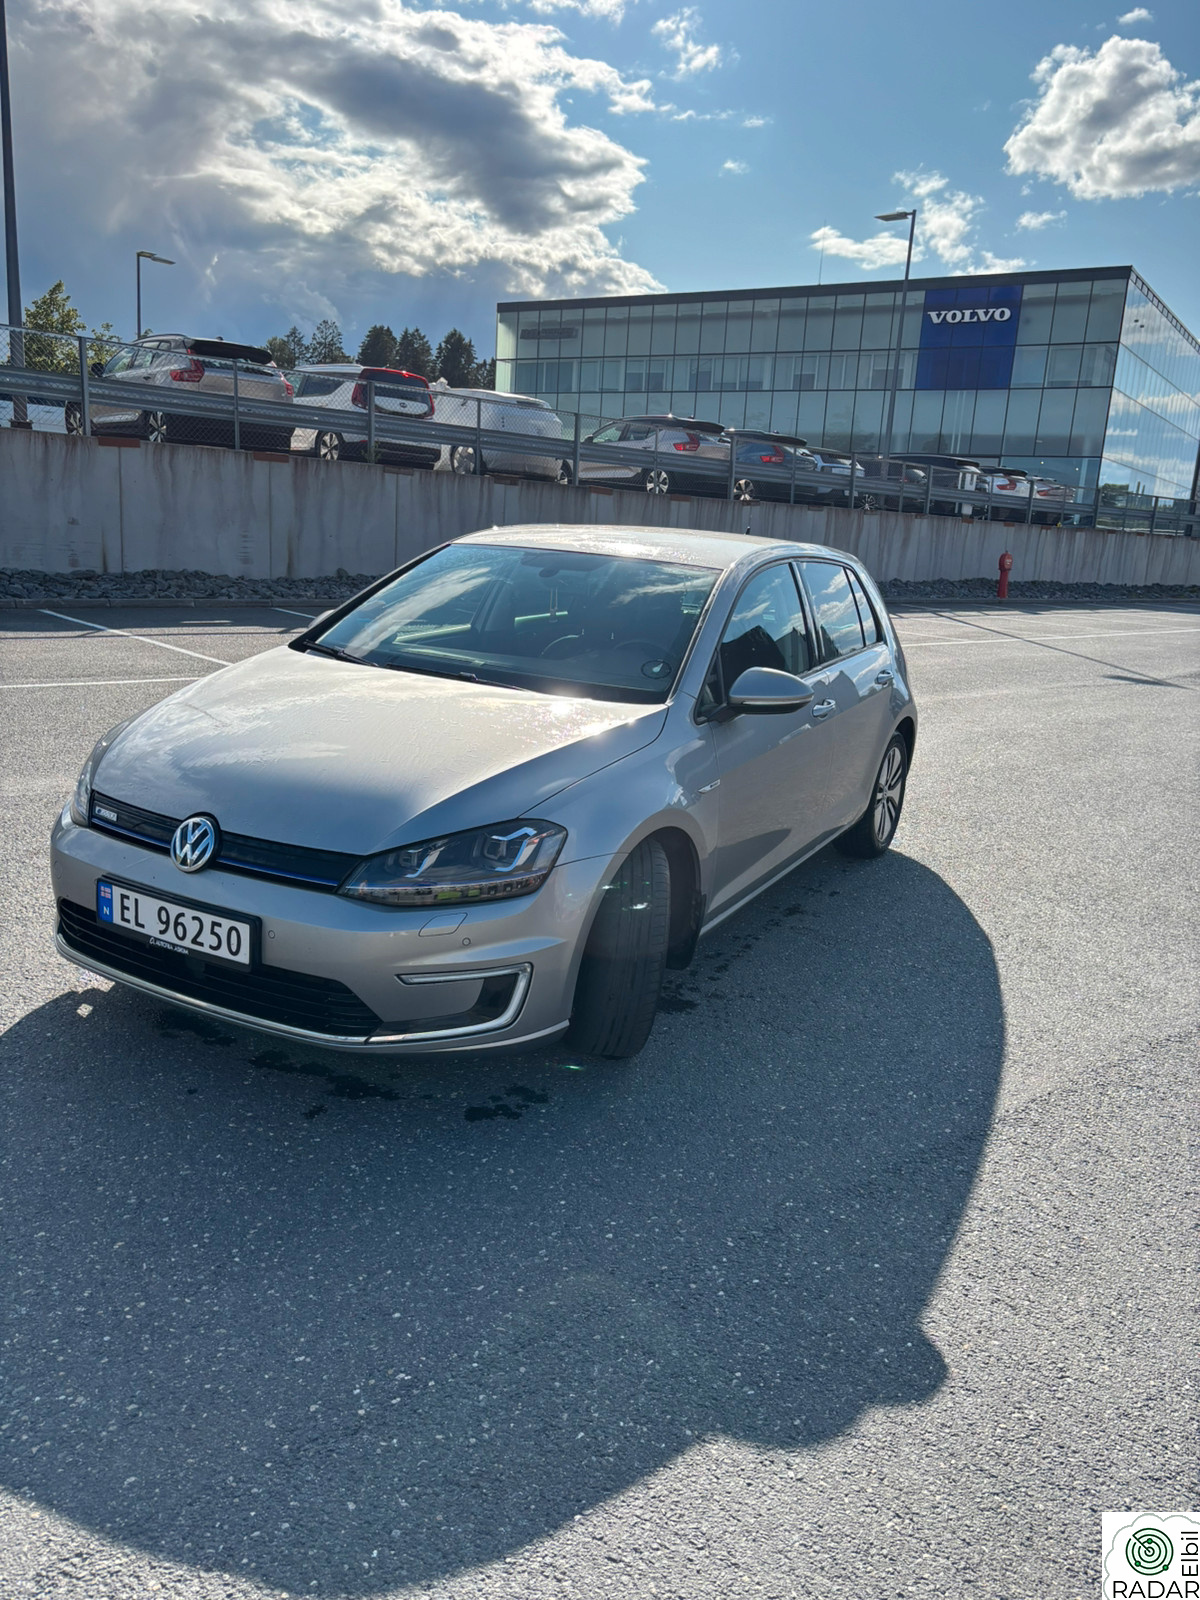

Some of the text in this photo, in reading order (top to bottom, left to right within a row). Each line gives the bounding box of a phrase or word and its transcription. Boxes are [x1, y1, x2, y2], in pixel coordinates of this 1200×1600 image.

[927, 307, 1011, 324] VOLVO
[103, 905, 110, 916] N
[119, 893, 242, 957] EL 96250
